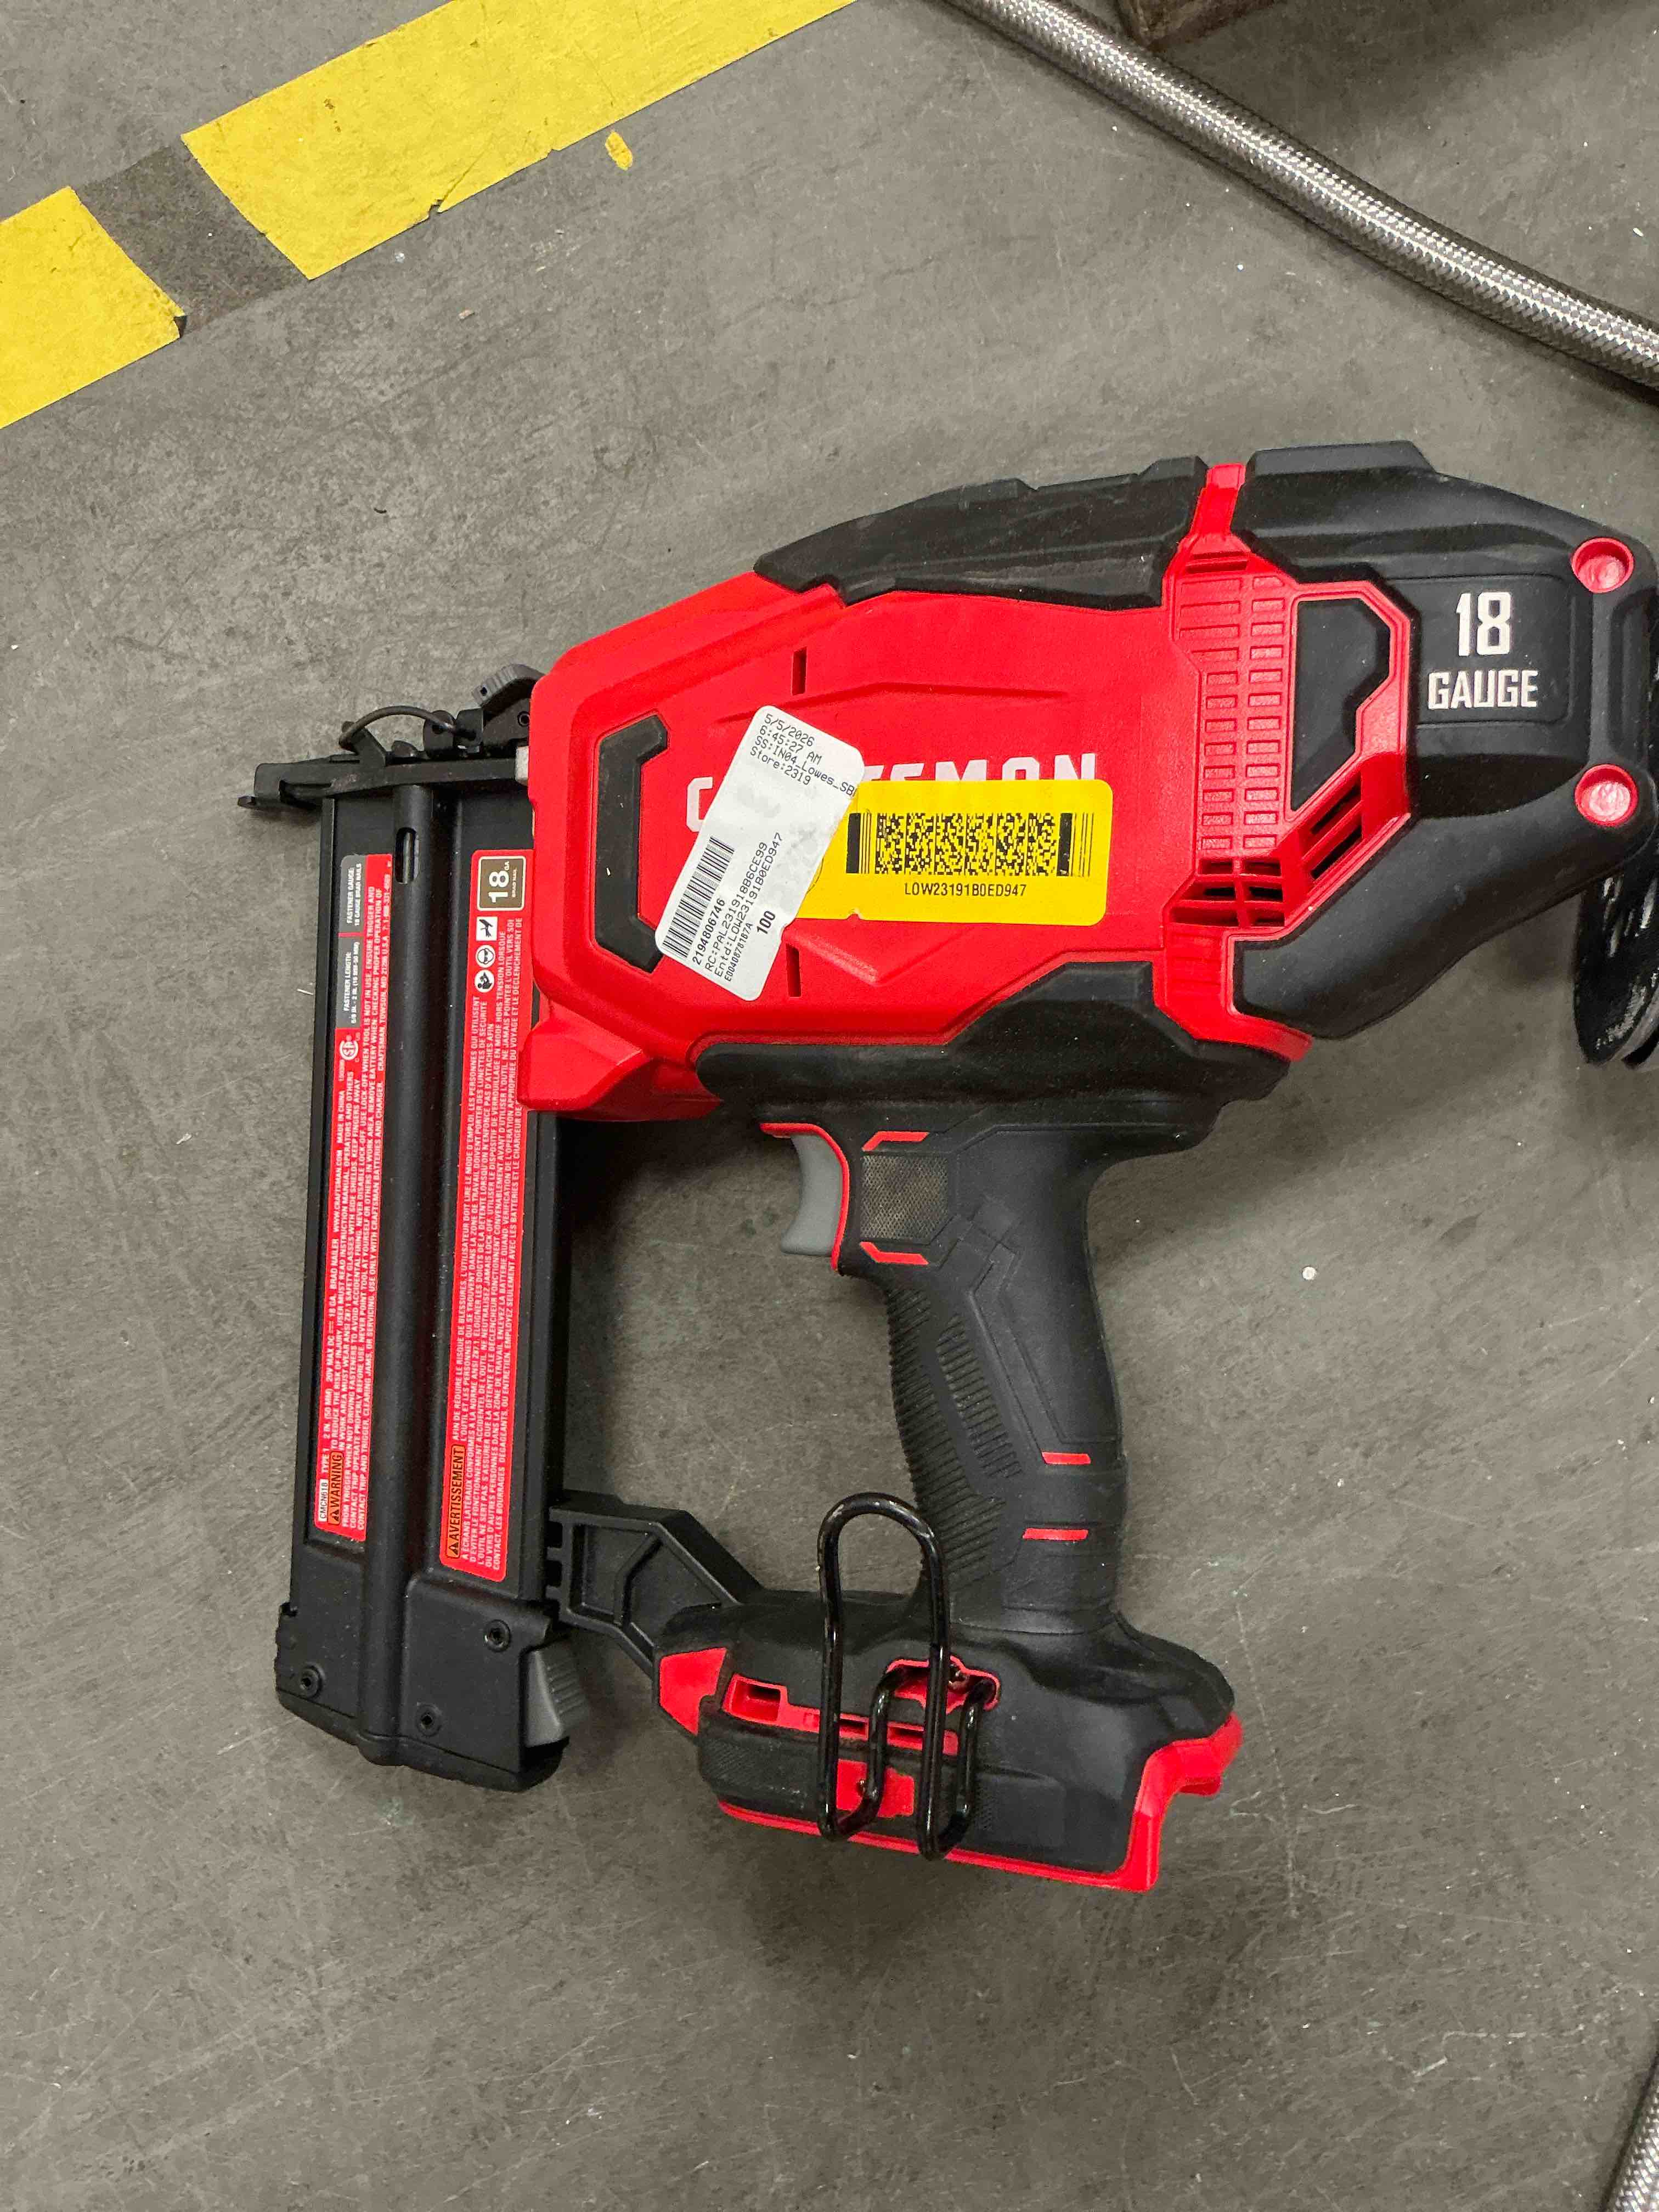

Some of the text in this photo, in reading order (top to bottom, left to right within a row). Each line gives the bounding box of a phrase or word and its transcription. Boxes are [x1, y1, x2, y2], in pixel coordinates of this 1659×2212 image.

[1455, 591, 1511, 657] 18
[1427, 670, 1538, 710] GAUGE
[759, 725, 822, 765] 6:45:27 AM
[764, 714, 816, 747] 5/5/2026
[750, 747, 811, 786] Store:2319
[375, 888, 382, 898] OF
[488, 870, 509, 902] 18
[904, 882, 1026, 896] LOW23191B0ED947
[374, 900, 382, 943] OPERATION
[692, 898, 725, 966] 2194806746
[757, 911, 775, 935] 100
[365, 989, 371, 998] IN
[471, 996, 479, 1034] UTILISENT
[469, 1051, 477, 1096] PERSONNES
[343, 1121, 351, 1167] OPERATORS
[373, 1138, 381, 1180] BATTERIES
[513, 1118, 521, 1159] CHARGEUR
[371, 1182, 379, 1230] CRAFTSMAN
[494, 1162, 503, 1234] CONVENABLEMENT
[510, 1181, 518, 1222] BATTERIES
[339, 1205, 348, 1257] INSTRUCTION
[352, 1256, 360, 1305] ACCIDENTAL
[362, 1259, 368, 1268] AT
[491, 1235, 500, 1296] FONCTIONNENT
[473, 1443, 482, 1516] FONCTIONNEMENT
[481, 1286, 489, 1338] NEUTRALISEZ
[492, 1060, 500, 1115] VERROUILLAGE
[329, 1307, 336, 1317] 18
[348, 1345, 357, 1390] FASTENERS
[463, 1339, 471, 1386] PERSONNES
[354, 1393, 362, 1434] PROPERLY
[363, 1376, 371, 1417] CLEARING
[330, 1453, 342, 1509] WARNING
[343, 1468, 351, 1503] TRIGGER
[490, 1446, 498, 1493] PERSONNES
[319, 1481, 328, 1519] CMCN618
[358, 1493, 366, 1531] CONTACT
[449, 1447, 463, 1541] AVERTISSEMENT
